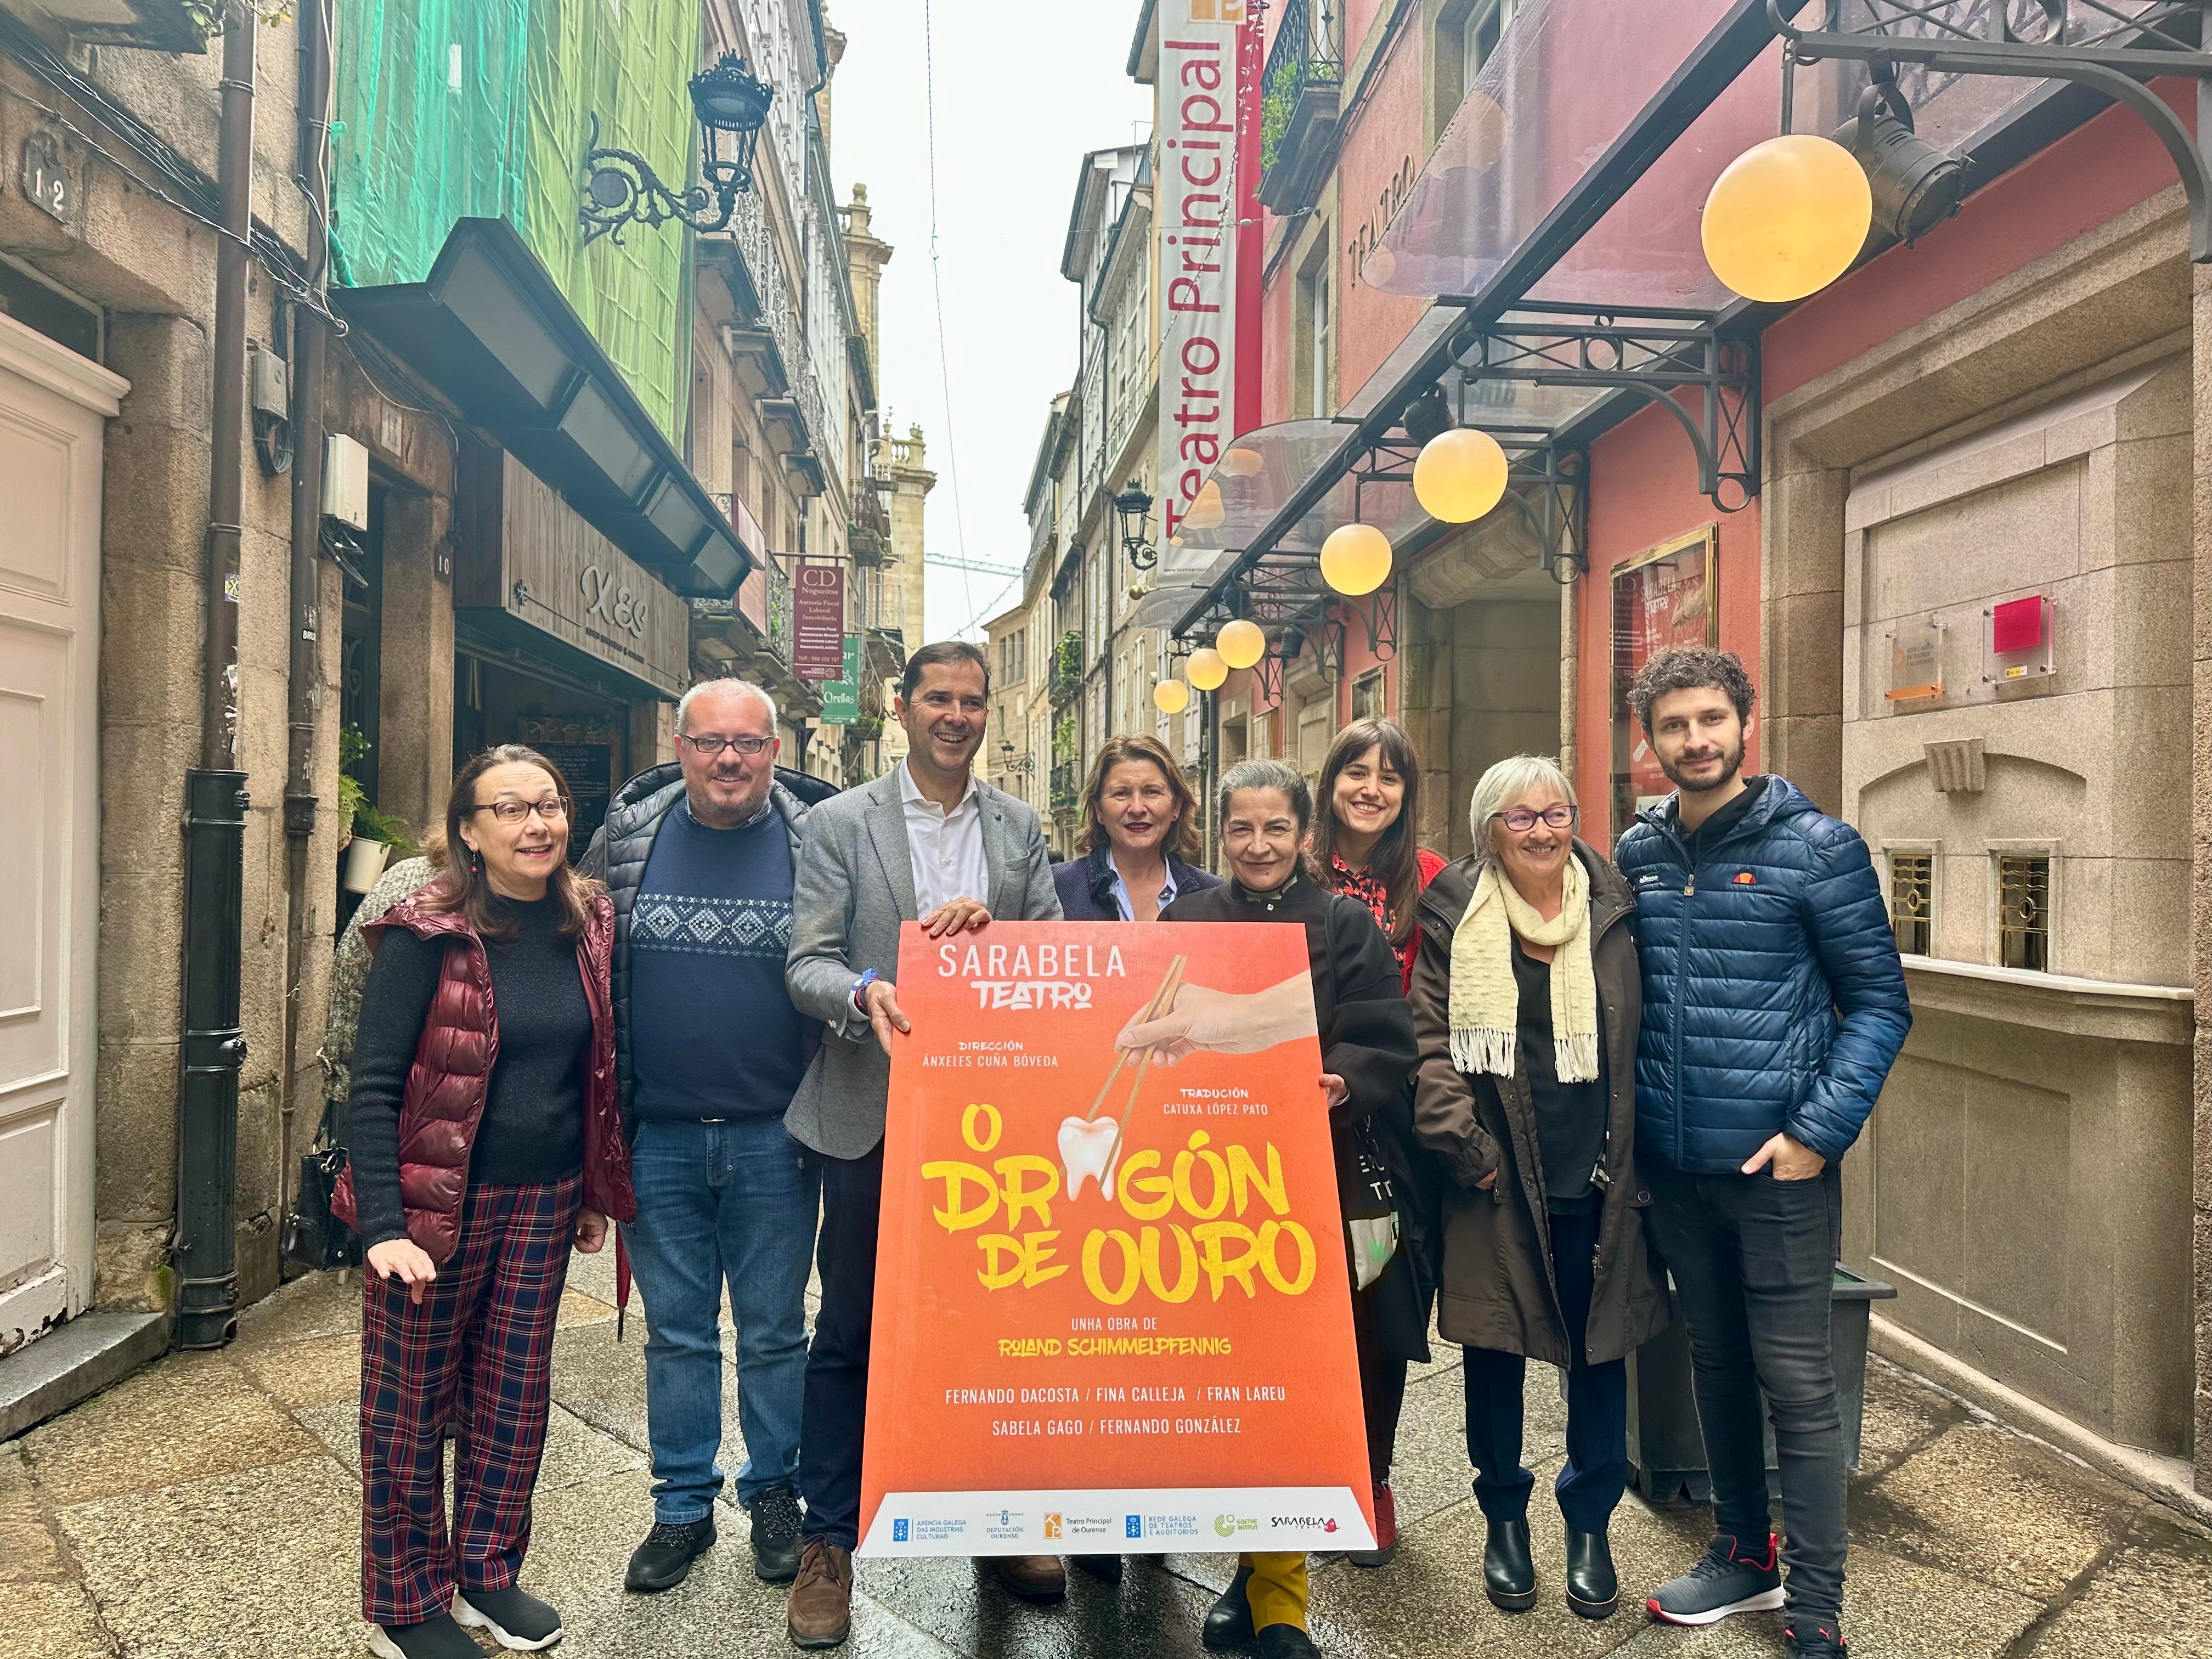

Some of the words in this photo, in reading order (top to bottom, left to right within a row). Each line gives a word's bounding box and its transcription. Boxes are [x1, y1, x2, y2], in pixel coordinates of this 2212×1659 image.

[1164, 40, 1234, 313] Principal
[35, 168, 64, 212] 12
[1166, 337, 1220, 538] Teatro
[438, 555, 449, 575] 10
[803, 569, 836, 587] CD
[802, 587, 838, 596] Nogueiras
[1641, 575, 1676, 602] SARABELA
[1646, 596, 1668, 614] TEATRO
[823, 691, 855, 704] Orellas
[1639, 874, 1658, 884] ellesse
[938, 944, 1126, 978] SARABELA
[970, 981, 1093, 1010] TEATRO
[957, 1040, 1023, 1052] DIRECCIÓN
[922, 1053, 972, 1067] ÁNXELES
[977, 1053, 1008, 1067] CUÑA
[1013, 1053, 1058, 1067] BÓVEDA
[1180, 1087, 1249, 1098] TRADUCIÓN
[1163, 1104, 1203, 1115] CATUXA
[1207, 1102, 1238, 1115] LÓPEZ
[1243, 1104, 1268, 1115] PATO
[961, 1104, 1002, 1152] O
[977, 1231, 1070, 1293] DE
[1081, 1220, 1317, 1305] OURO
[1071, 1318, 1102, 1330] UNHA
[1108, 1317, 1138, 1330] OBRA
[1143, 1317, 1158, 1330] DE
[998, 1338, 1062, 1357] ROLAND
[1068, 1337, 1232, 1356] SCHIMMELPFENNIG
[946, 1389, 1014, 1404] FERNANDO
[1021, 1388, 1080, 1403] DACOSTA
[1097, 1387, 1126, 1402] FINA
[1132, 1387, 1186, 1402] CALLEJA
[1208, 1387, 1240, 1401] FRAN
[1246, 1386, 1286, 1401] LAREU
[992, 1420, 1041, 1436] SABELA
[1047, 1419, 1083, 1435] GAGO
[1101, 1419, 1170, 1435] FERNANDO
[1176, 1415, 1241, 1434] GONZÁLEZ
[1086, 1517, 1111, 1526] Principal
[1271, 1517, 1326, 1527] SARABELA
